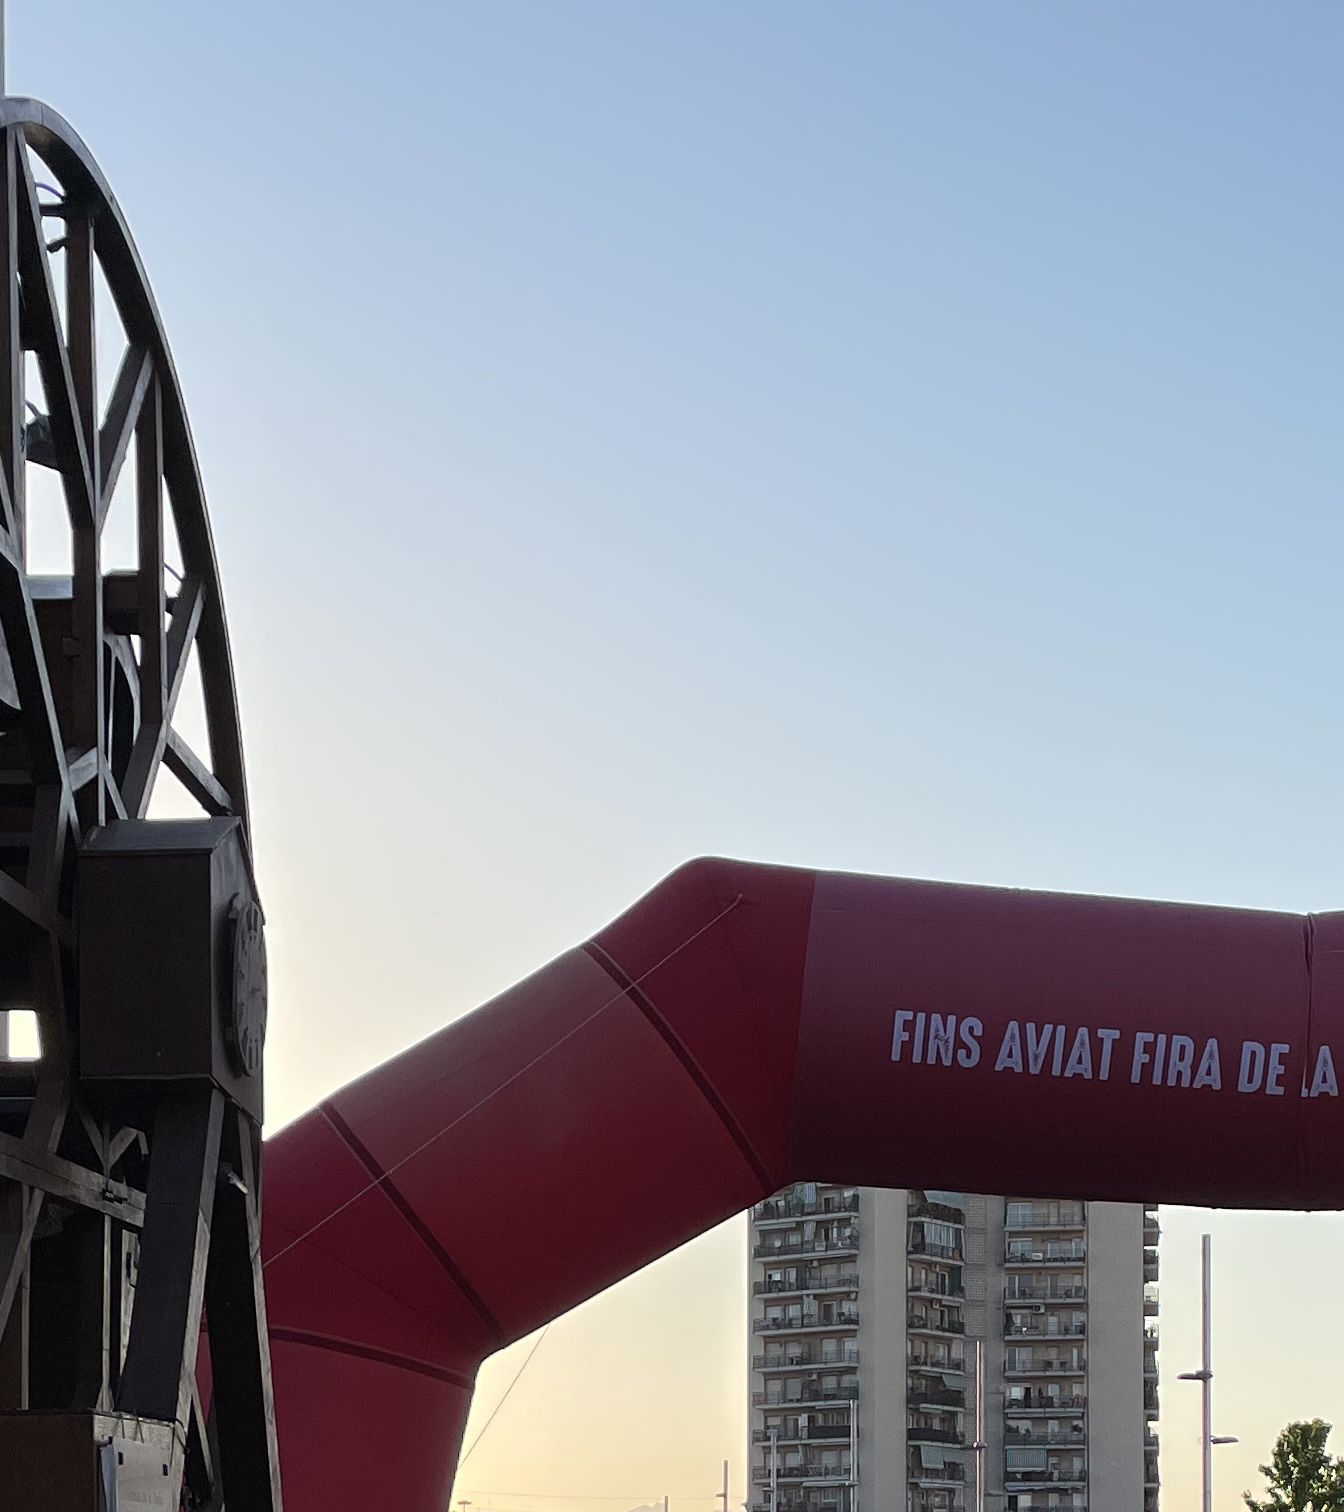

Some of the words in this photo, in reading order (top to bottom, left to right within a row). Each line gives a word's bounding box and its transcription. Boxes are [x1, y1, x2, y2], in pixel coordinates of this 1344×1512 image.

[890, 1009, 983, 1069] FINS
[994, 1020, 1121, 1081] AVIAT
[1131, 1032, 1222, 1091] FIRA
[1237, 1040, 1291, 1096] DE
